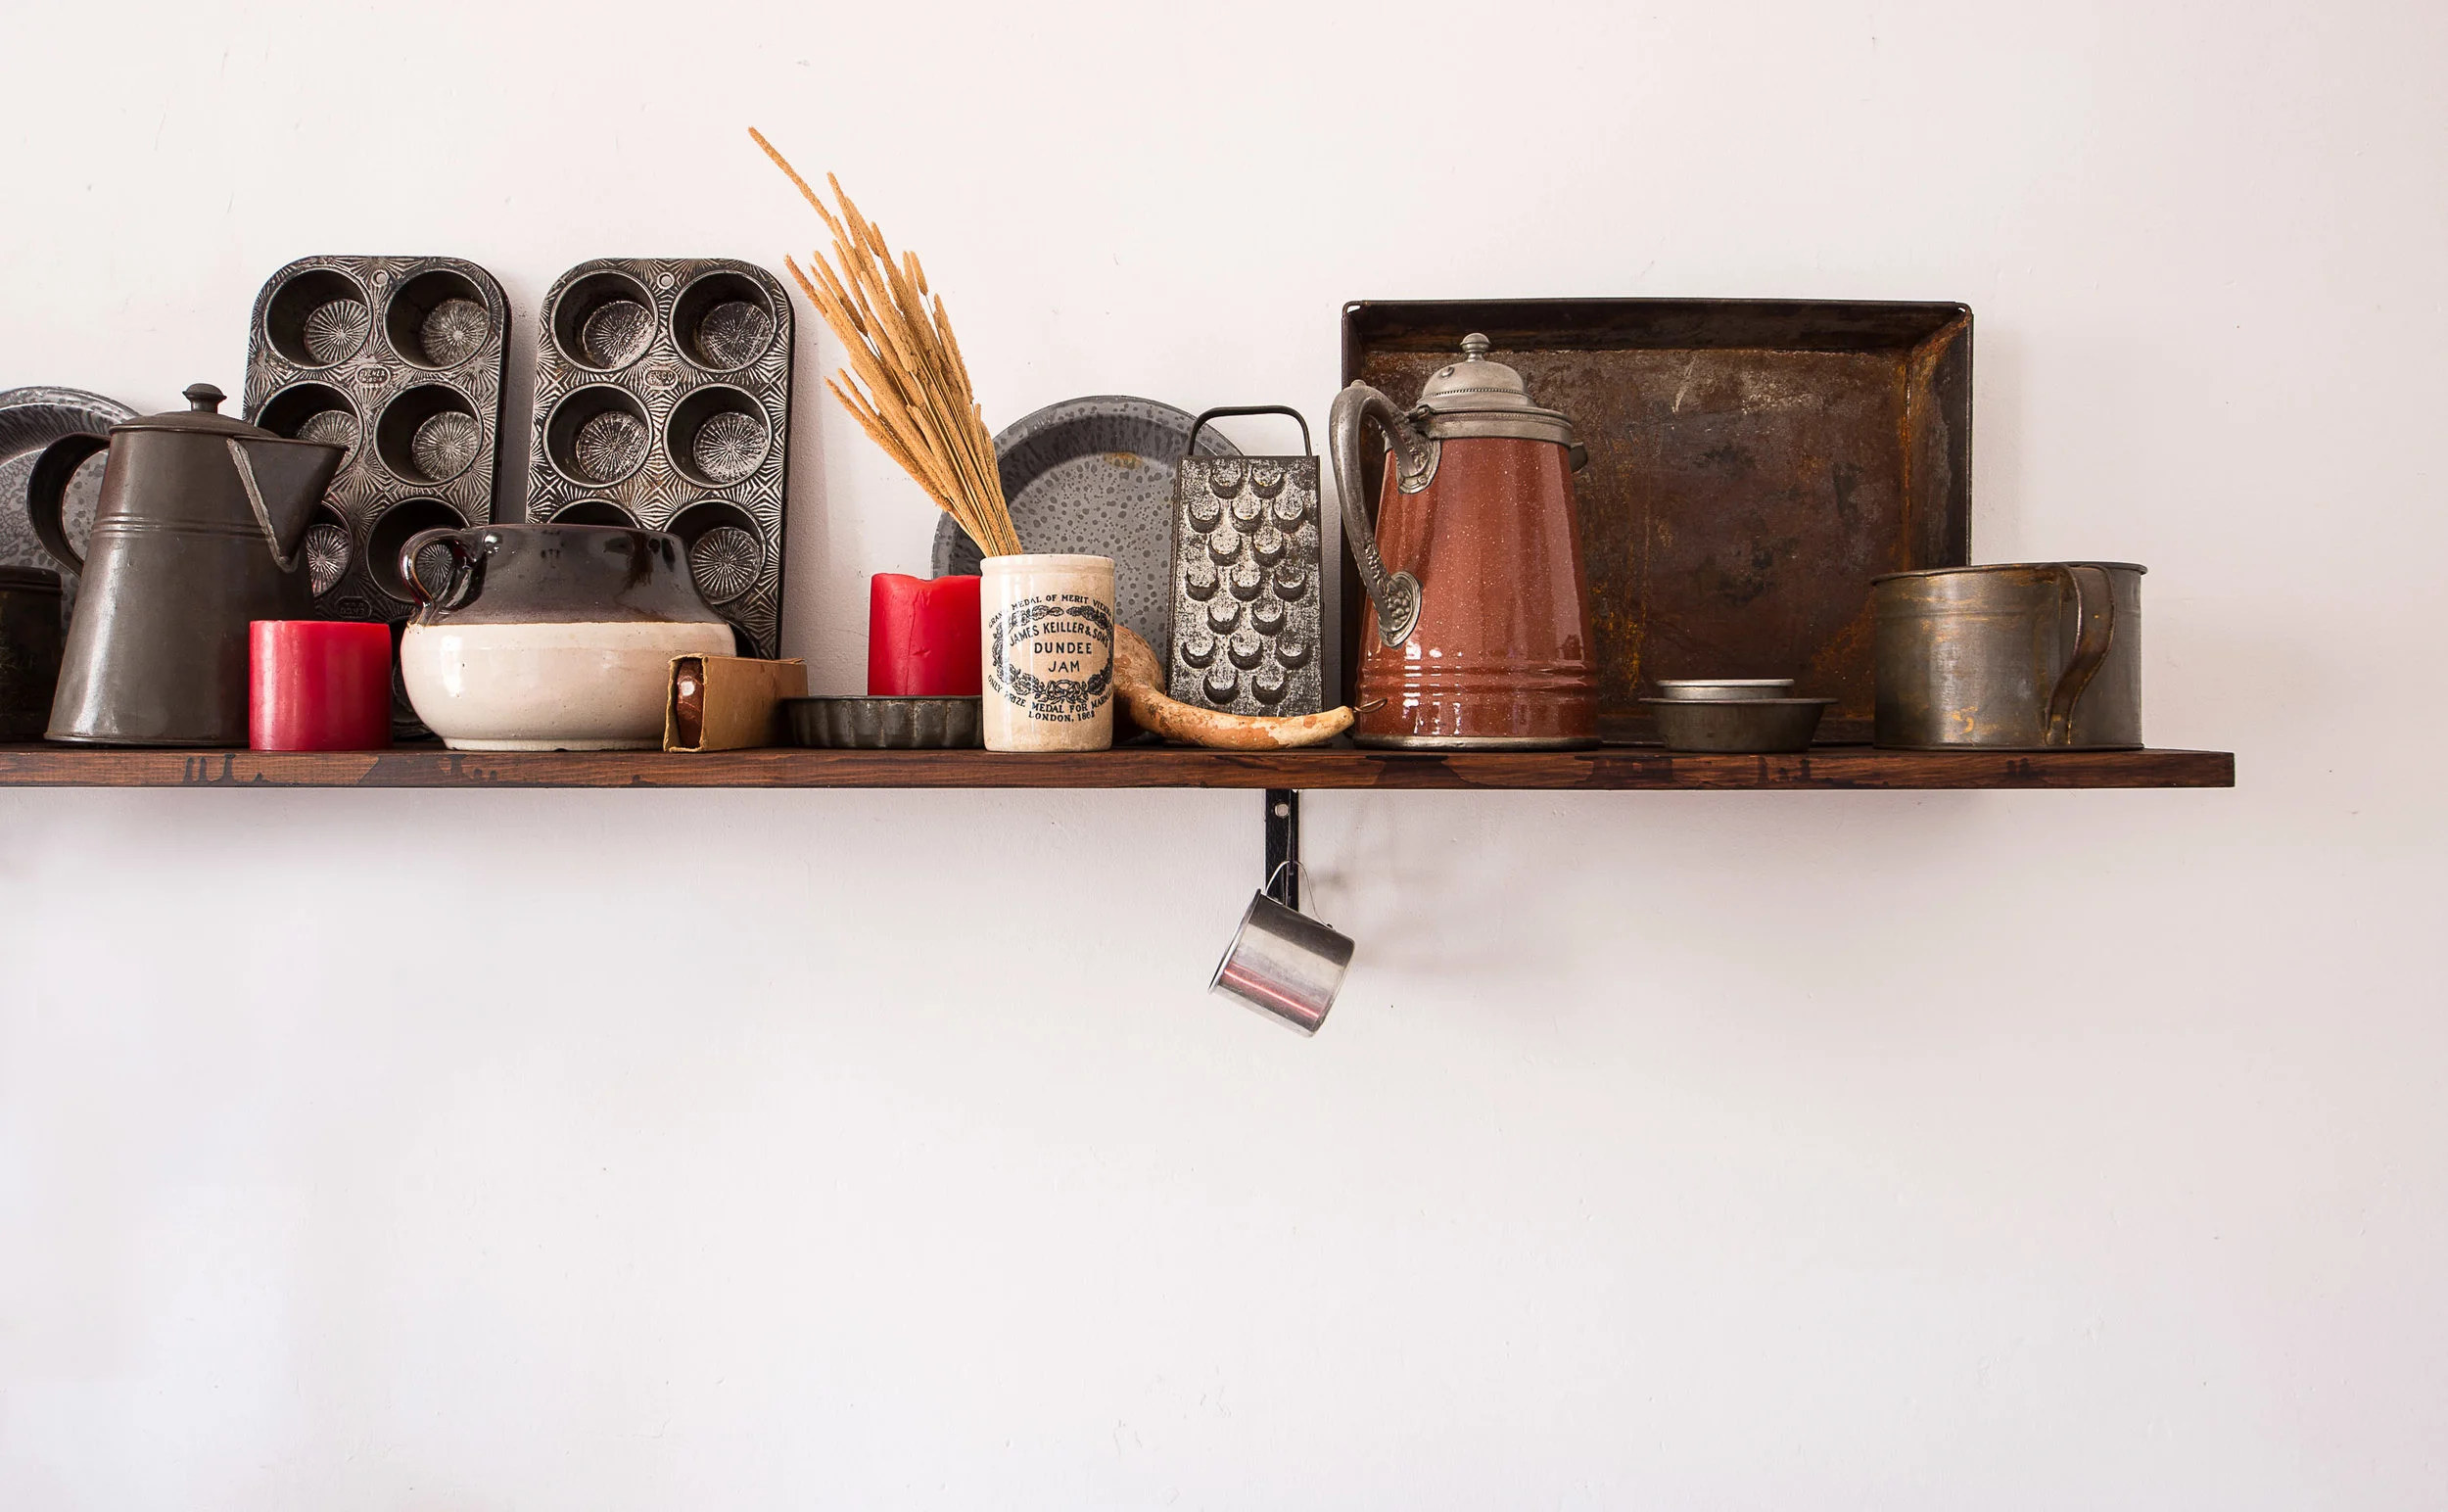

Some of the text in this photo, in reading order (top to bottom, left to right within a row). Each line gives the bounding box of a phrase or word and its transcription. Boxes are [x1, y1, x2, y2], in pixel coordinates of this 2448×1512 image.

[988, 608, 1009, 629] GRAN
[1012, 596, 1042, 610] MEDAL
[1061, 594, 1089, 604] MERIT
[1010, 625, 1040, 646] JAMES
[1034, 642, 1092, 654] DUNDEE
[1048, 660, 1080, 673] JAM
[988, 675, 1003, 693] ONLY
[1032, 701, 1064, 713] MEDAL
[1069, 704, 1088, 713] FOR
[1028, 711, 1074, 723] LONDON,
